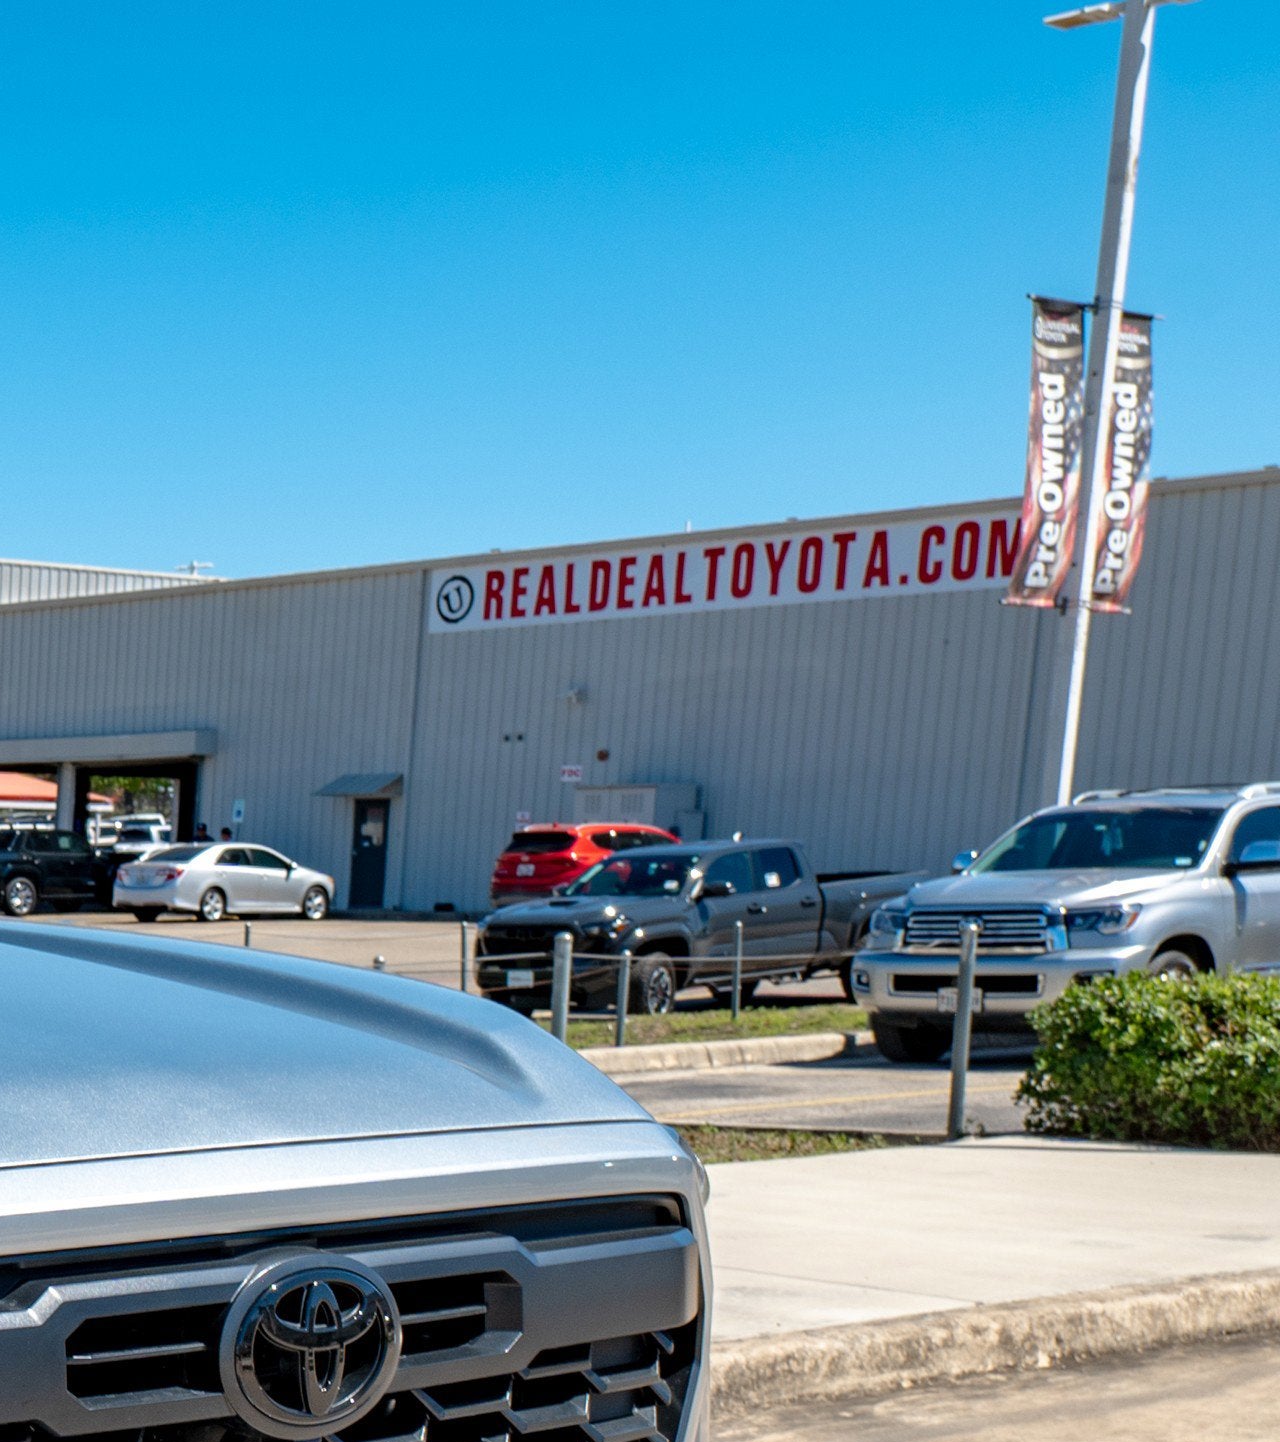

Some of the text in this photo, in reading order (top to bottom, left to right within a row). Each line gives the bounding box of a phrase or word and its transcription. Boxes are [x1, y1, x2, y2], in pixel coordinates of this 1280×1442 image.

[483, 518, 1022, 620] REALDEALTOYOTA.COM
[1025, 372, 1066, 588] Pre Owned
[1093, 382, 1138, 594] Pre Owned
